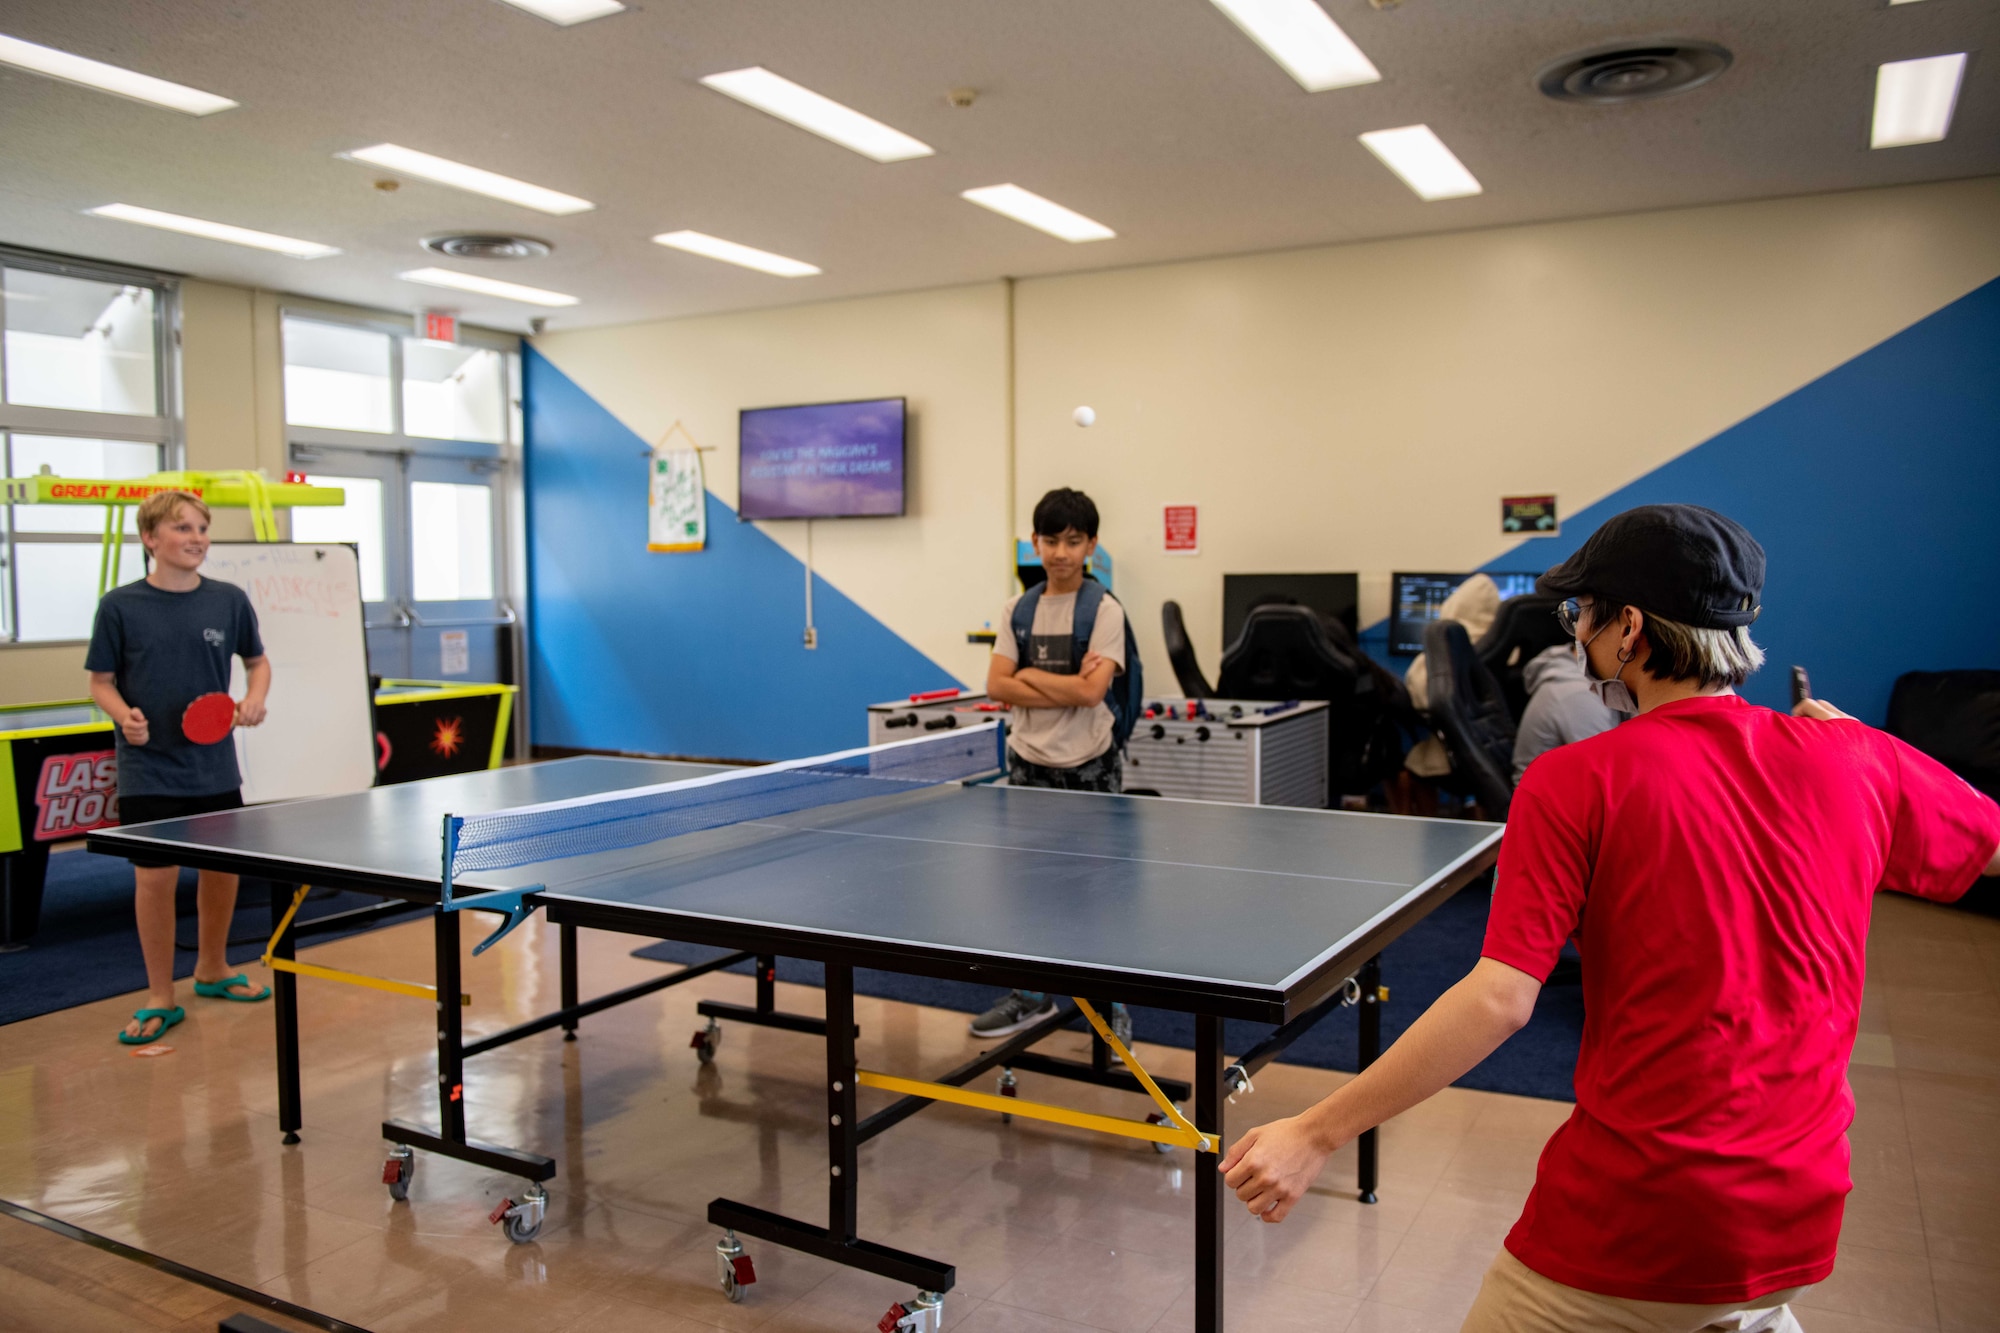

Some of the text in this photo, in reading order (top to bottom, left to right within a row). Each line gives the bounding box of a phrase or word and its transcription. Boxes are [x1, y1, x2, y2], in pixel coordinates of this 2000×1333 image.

[797, 446, 816, 459] THE
[806, 463, 817, 475] IN
[819, 461, 847, 476] THEIR
[51, 484, 109, 499] GREAT
